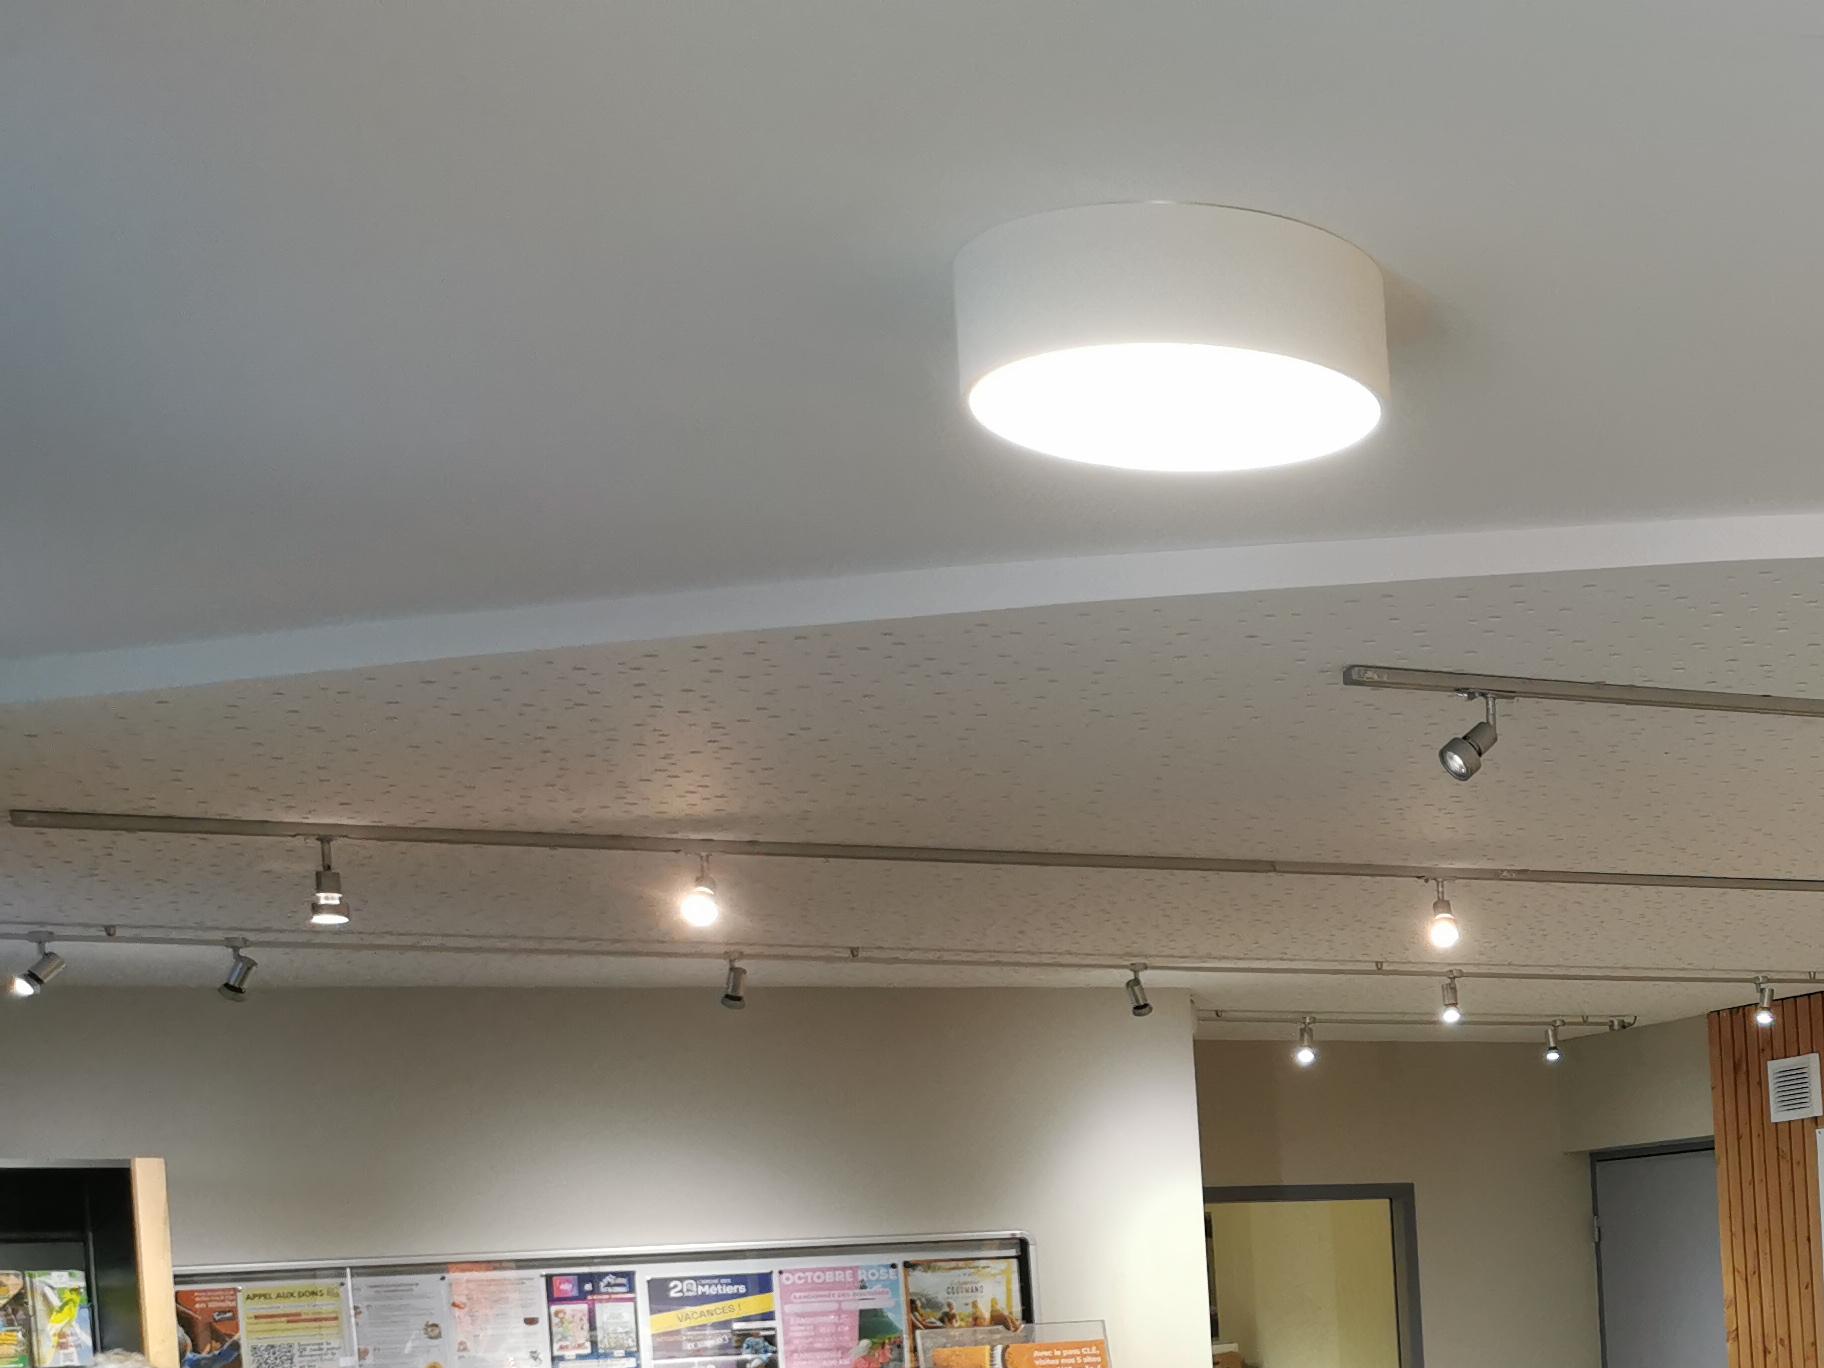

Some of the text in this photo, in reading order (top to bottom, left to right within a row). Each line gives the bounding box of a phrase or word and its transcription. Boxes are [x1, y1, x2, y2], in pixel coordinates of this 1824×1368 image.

[782, 1266, 898, 1285] OCTOBRE ROSE
[245, 1291, 275, 1301] APPEL
[276, 1291, 297, 1299] AUX
[297, 1290, 324, 1298] DONS
[698, 1282, 747, 1296] Métiers
[676, 1304, 736, 1322] VACANCES
